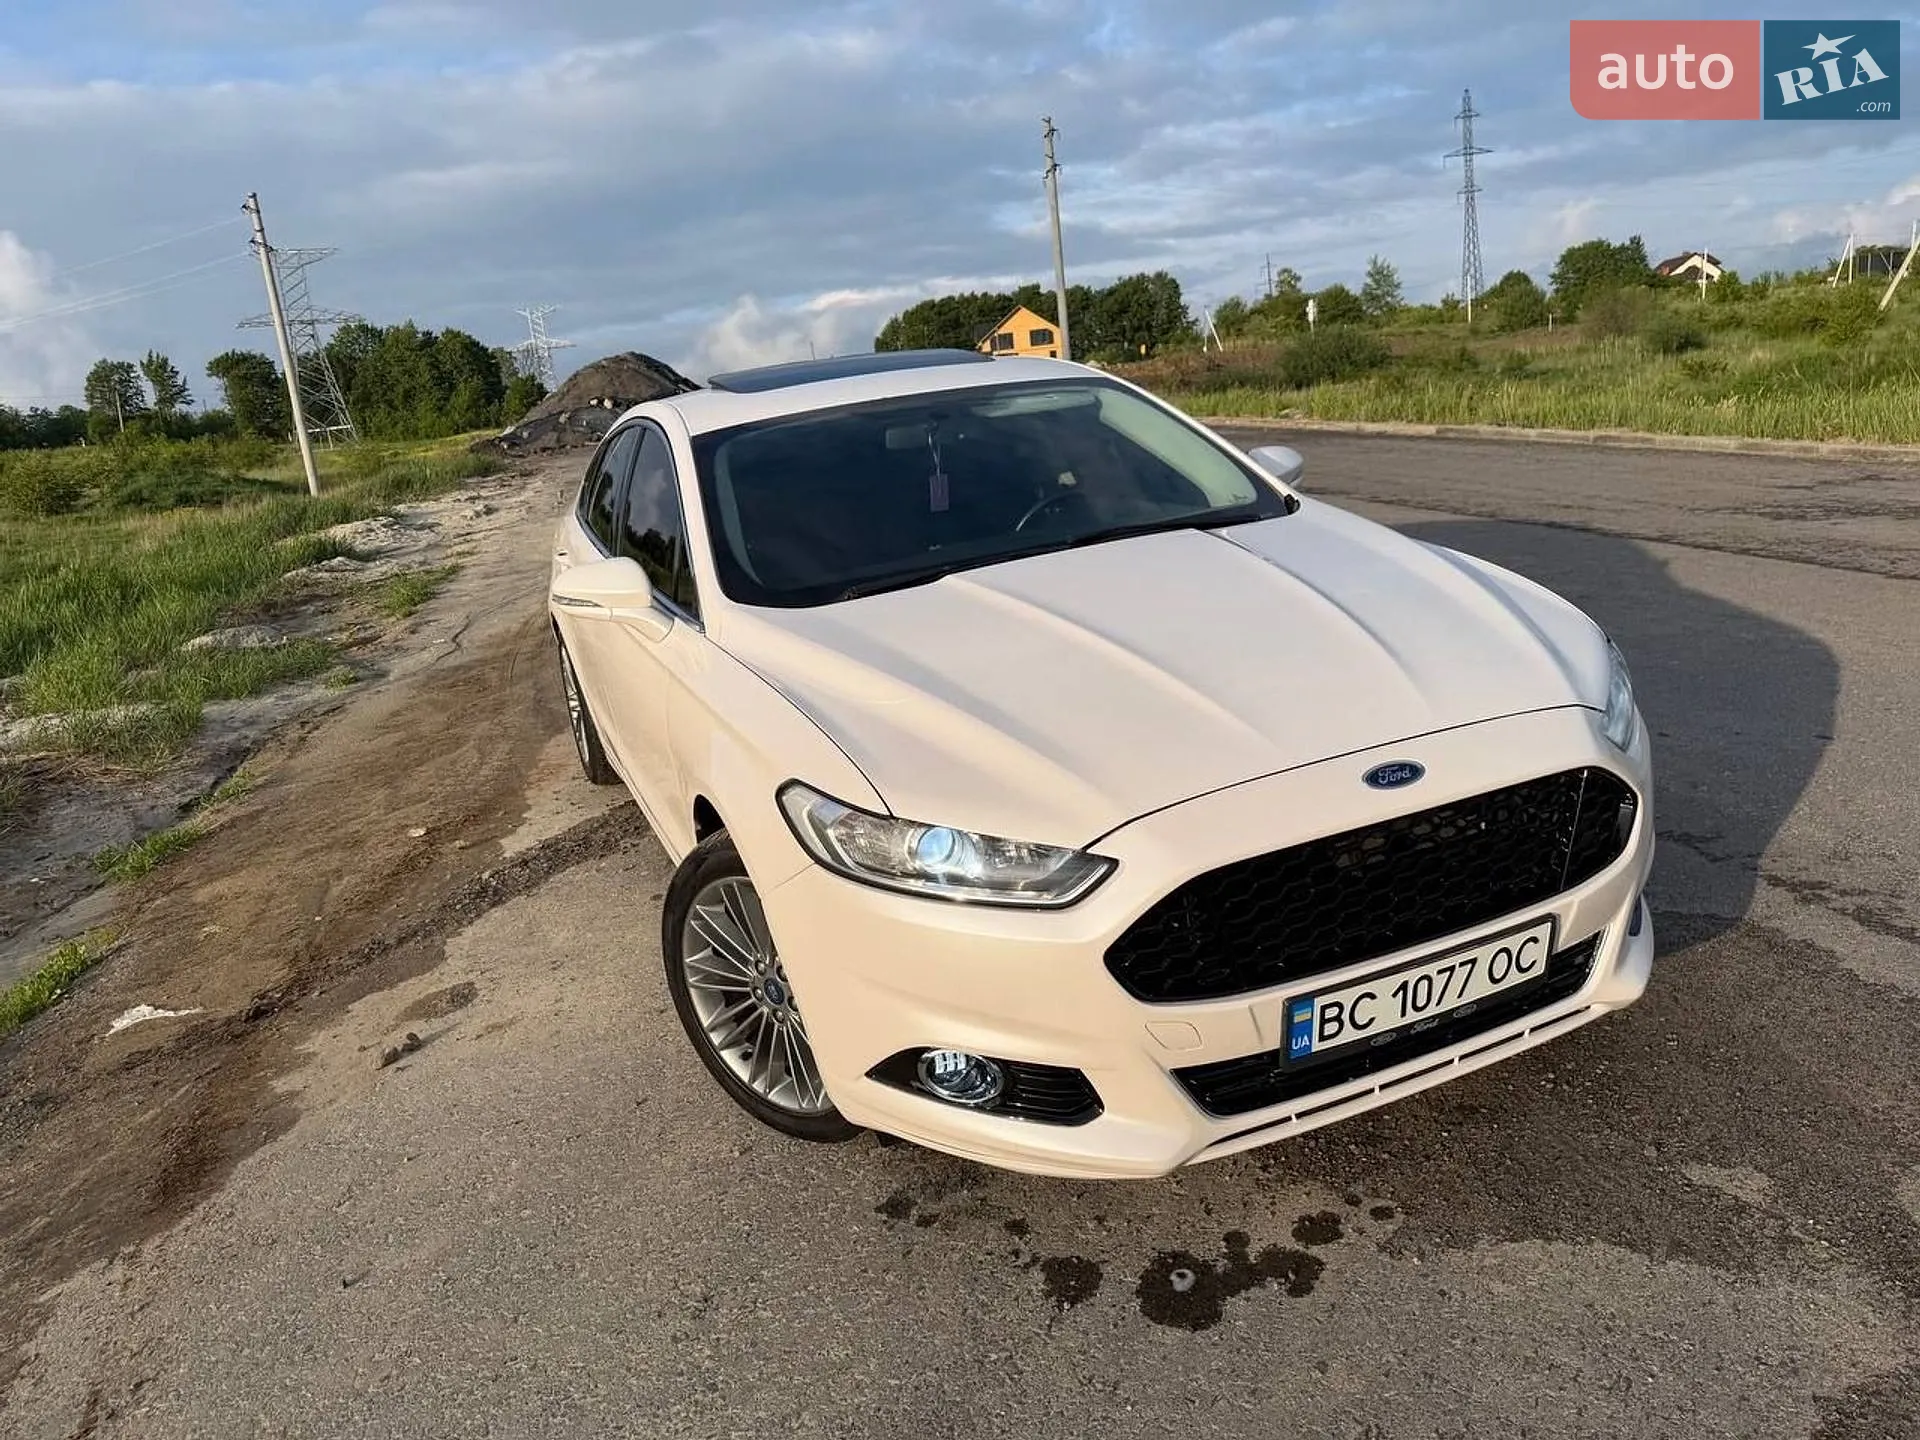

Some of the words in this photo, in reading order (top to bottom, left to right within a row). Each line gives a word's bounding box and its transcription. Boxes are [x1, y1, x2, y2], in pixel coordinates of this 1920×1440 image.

[1378, 765, 1412, 785] Ford
[1318, 991, 1378, 1043] BC
[1391, 957, 1478, 1019] 1077
[1487, 936, 1540, 985] OC
[1291, 1034, 1310, 1050] UA
